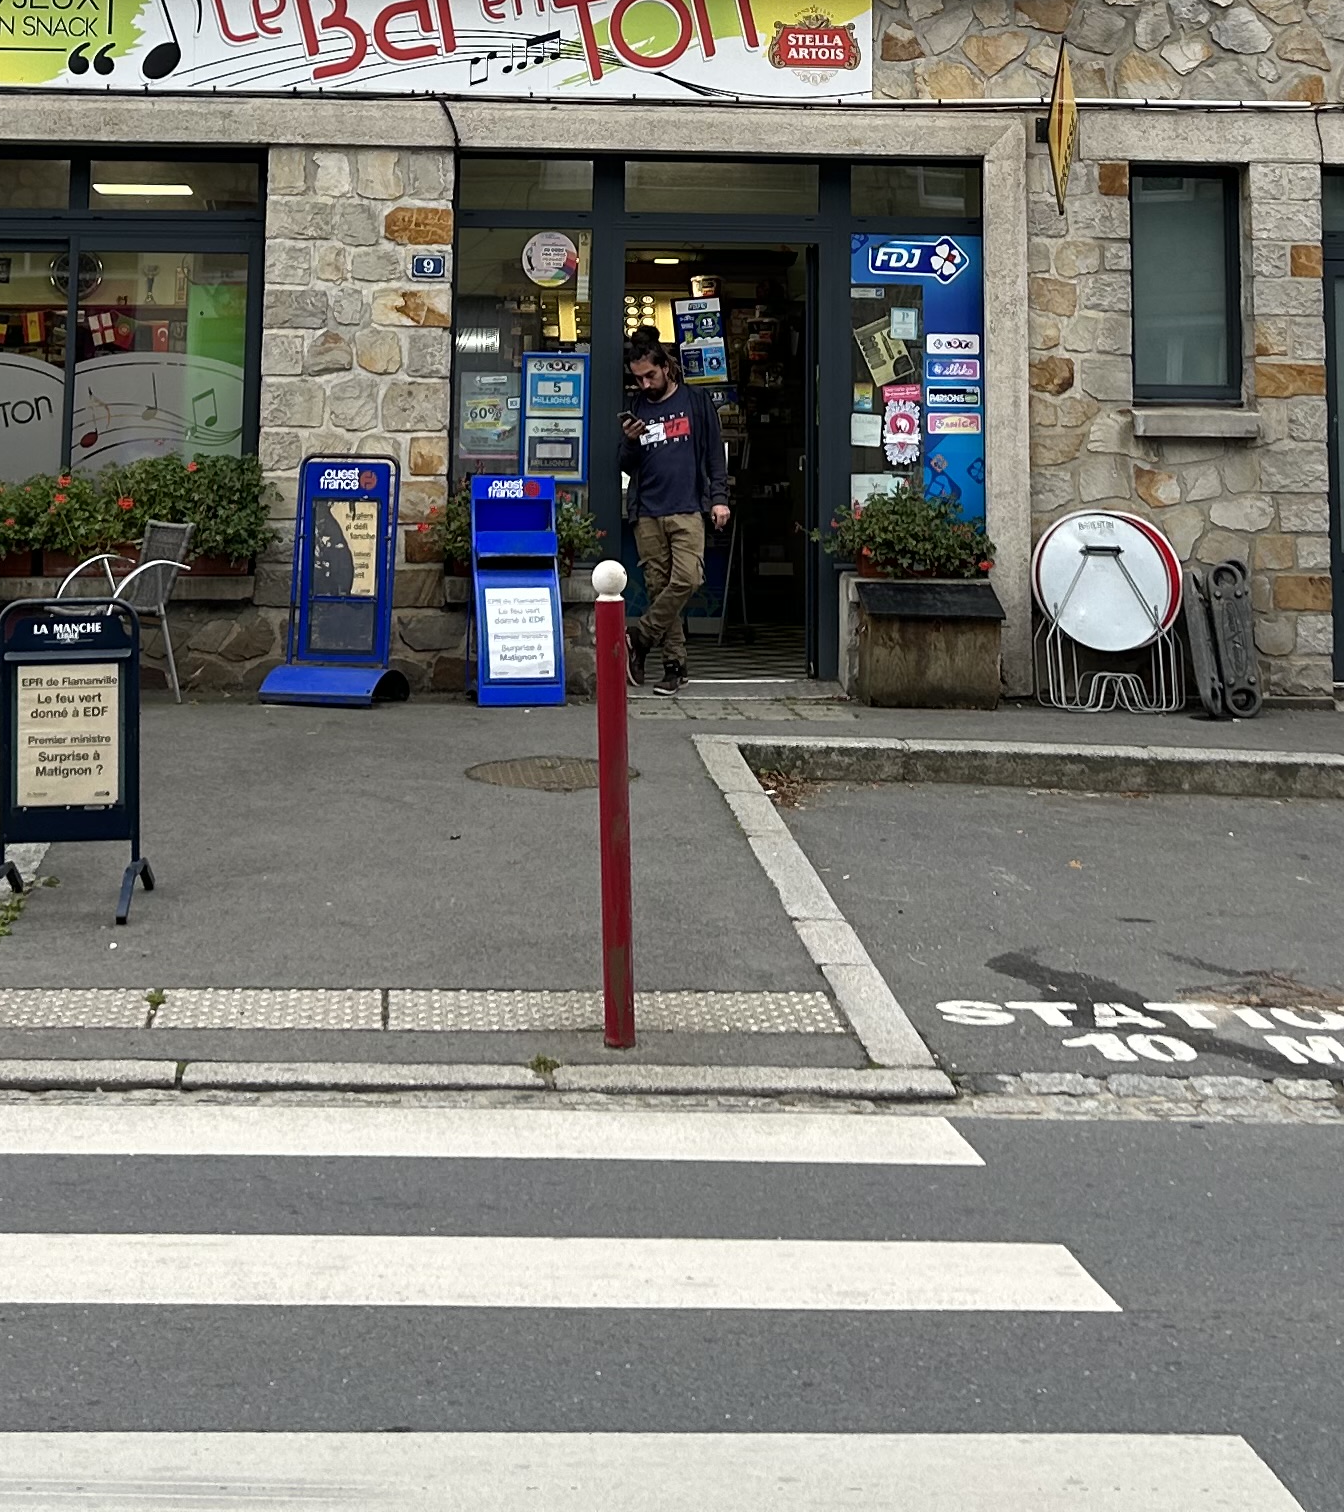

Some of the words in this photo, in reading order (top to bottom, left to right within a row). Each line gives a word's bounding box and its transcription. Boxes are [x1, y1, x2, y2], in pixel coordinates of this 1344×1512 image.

[22, 16, 99, 38] SNACK
[787, 34, 843, 46] STELLA
[787, 48, 845, 60] ARTOIS
[875, 247, 922, 268] FDJ
[422, 258, 435, 273] 9
[553, 381, 561, 393] 5
[649, 411, 684, 424] OMMY
[324, 467, 359, 480] ouest
[320, 476, 359, 490] france
[492, 478, 524, 489] ouest
[488, 486, 524, 498] france
[33, 623, 49, 635] LA
[53, 621, 102, 634] MANCHE
[21, 677, 43, 687] EPR
[46, 677, 59, 686] de
[62, 675, 117, 686] Flamanville
[37, 693, 52, 704] Le
[56, 692, 74, 704] feu
[78, 692, 102, 703] vert
[30, 707, 68, 719] donné
[72, 707, 79, 718] à
[83, 706, 108, 717] EDF
[28, 736, 67, 745] Premier
[70, 734, 111, 744] ministre
[38, 750, 89, 763] Surprise
[93, 750, 100, 761] à
[35, 766, 92, 778] Matignon
[96, 764, 104, 775] ?
[1062, 1031, 1198, 1063] 10
